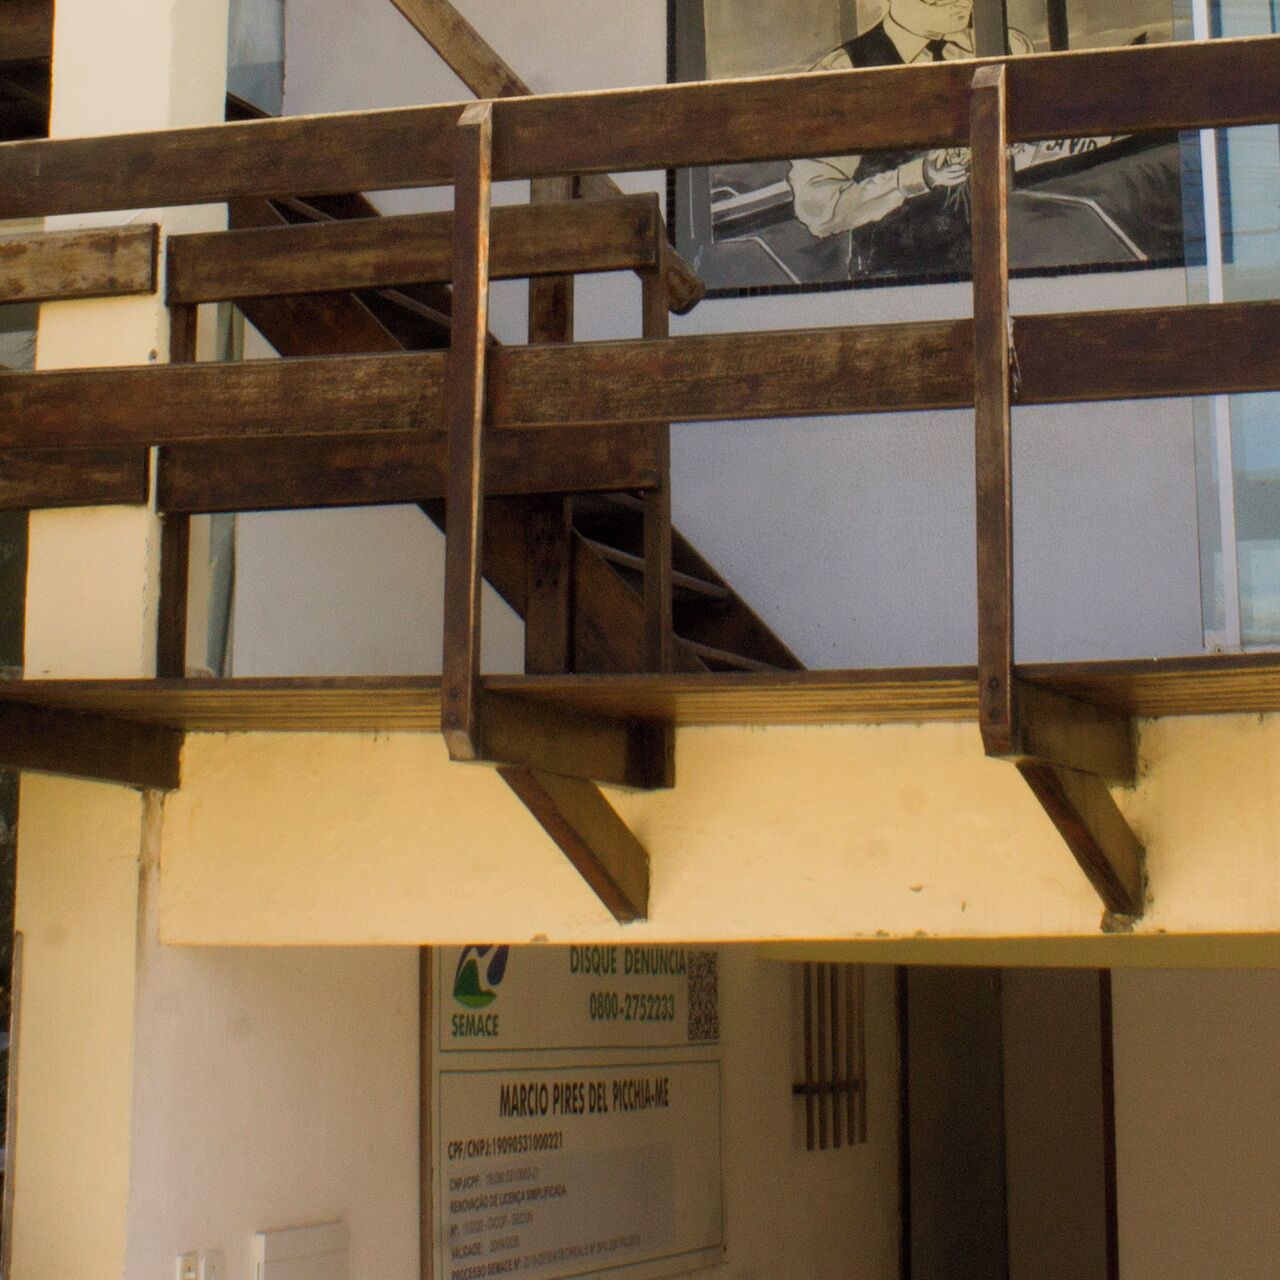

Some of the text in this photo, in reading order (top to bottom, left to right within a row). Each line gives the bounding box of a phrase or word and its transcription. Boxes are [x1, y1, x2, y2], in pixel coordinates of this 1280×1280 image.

[569, 945, 617, 974] DISQUE
[451, 1014, 499, 1037] SEMACE
[499, 1076, 669, 1118] MARCIO PIRES DEL PICCHIA-ME
